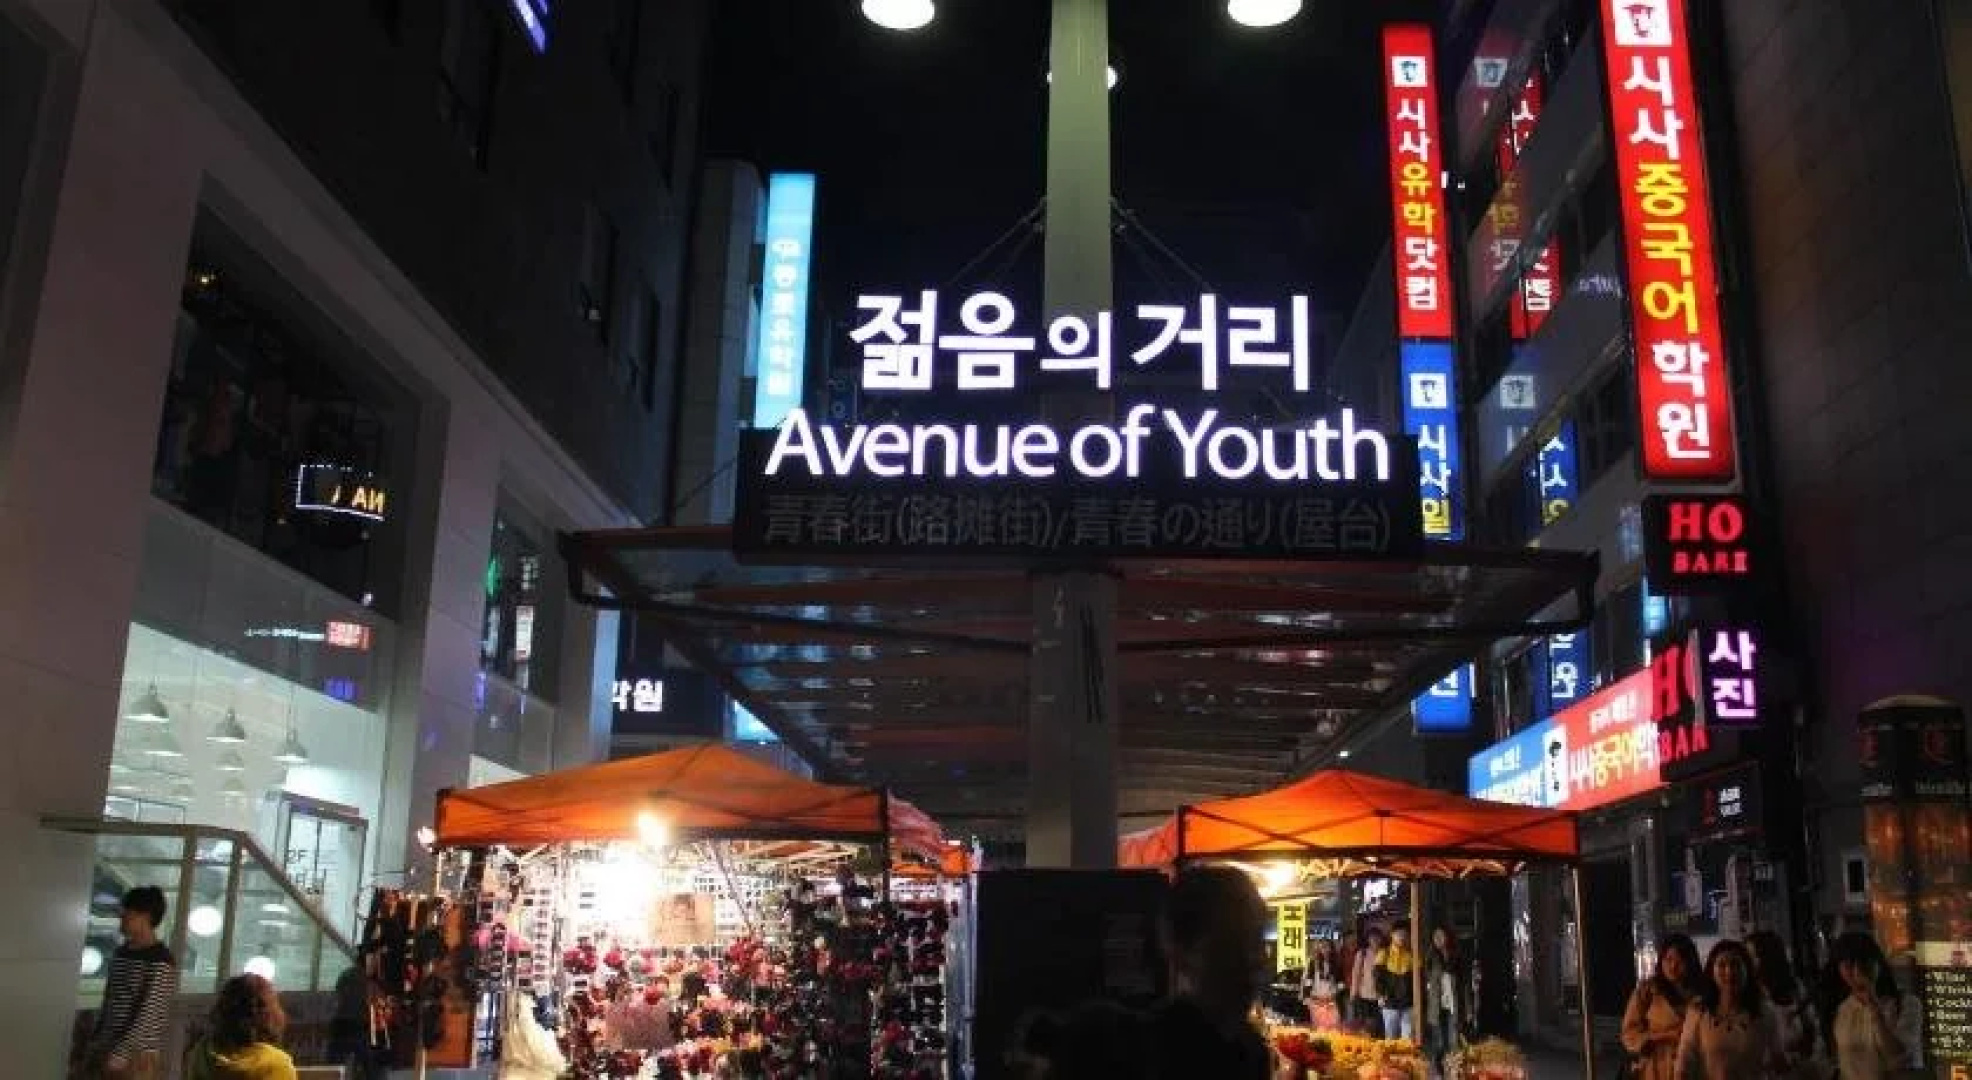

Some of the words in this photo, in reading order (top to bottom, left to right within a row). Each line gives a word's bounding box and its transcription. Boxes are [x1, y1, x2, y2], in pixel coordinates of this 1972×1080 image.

[1396, 97, 1439, 312] 시사유학닷컴
[1623, 55, 1710, 460] 시사중국어학원
[848, 290, 1113, 392] 젊음의
[1132, 293, 1310, 393] 거리
[763, 409, 1058, 479] Avenue
[1069, 403, 1155, 480] of
[1162, 407, 1391, 482] Youth
[1668, 502, 1743, 543] HO
[1708, 630, 1757, 719] 사진
